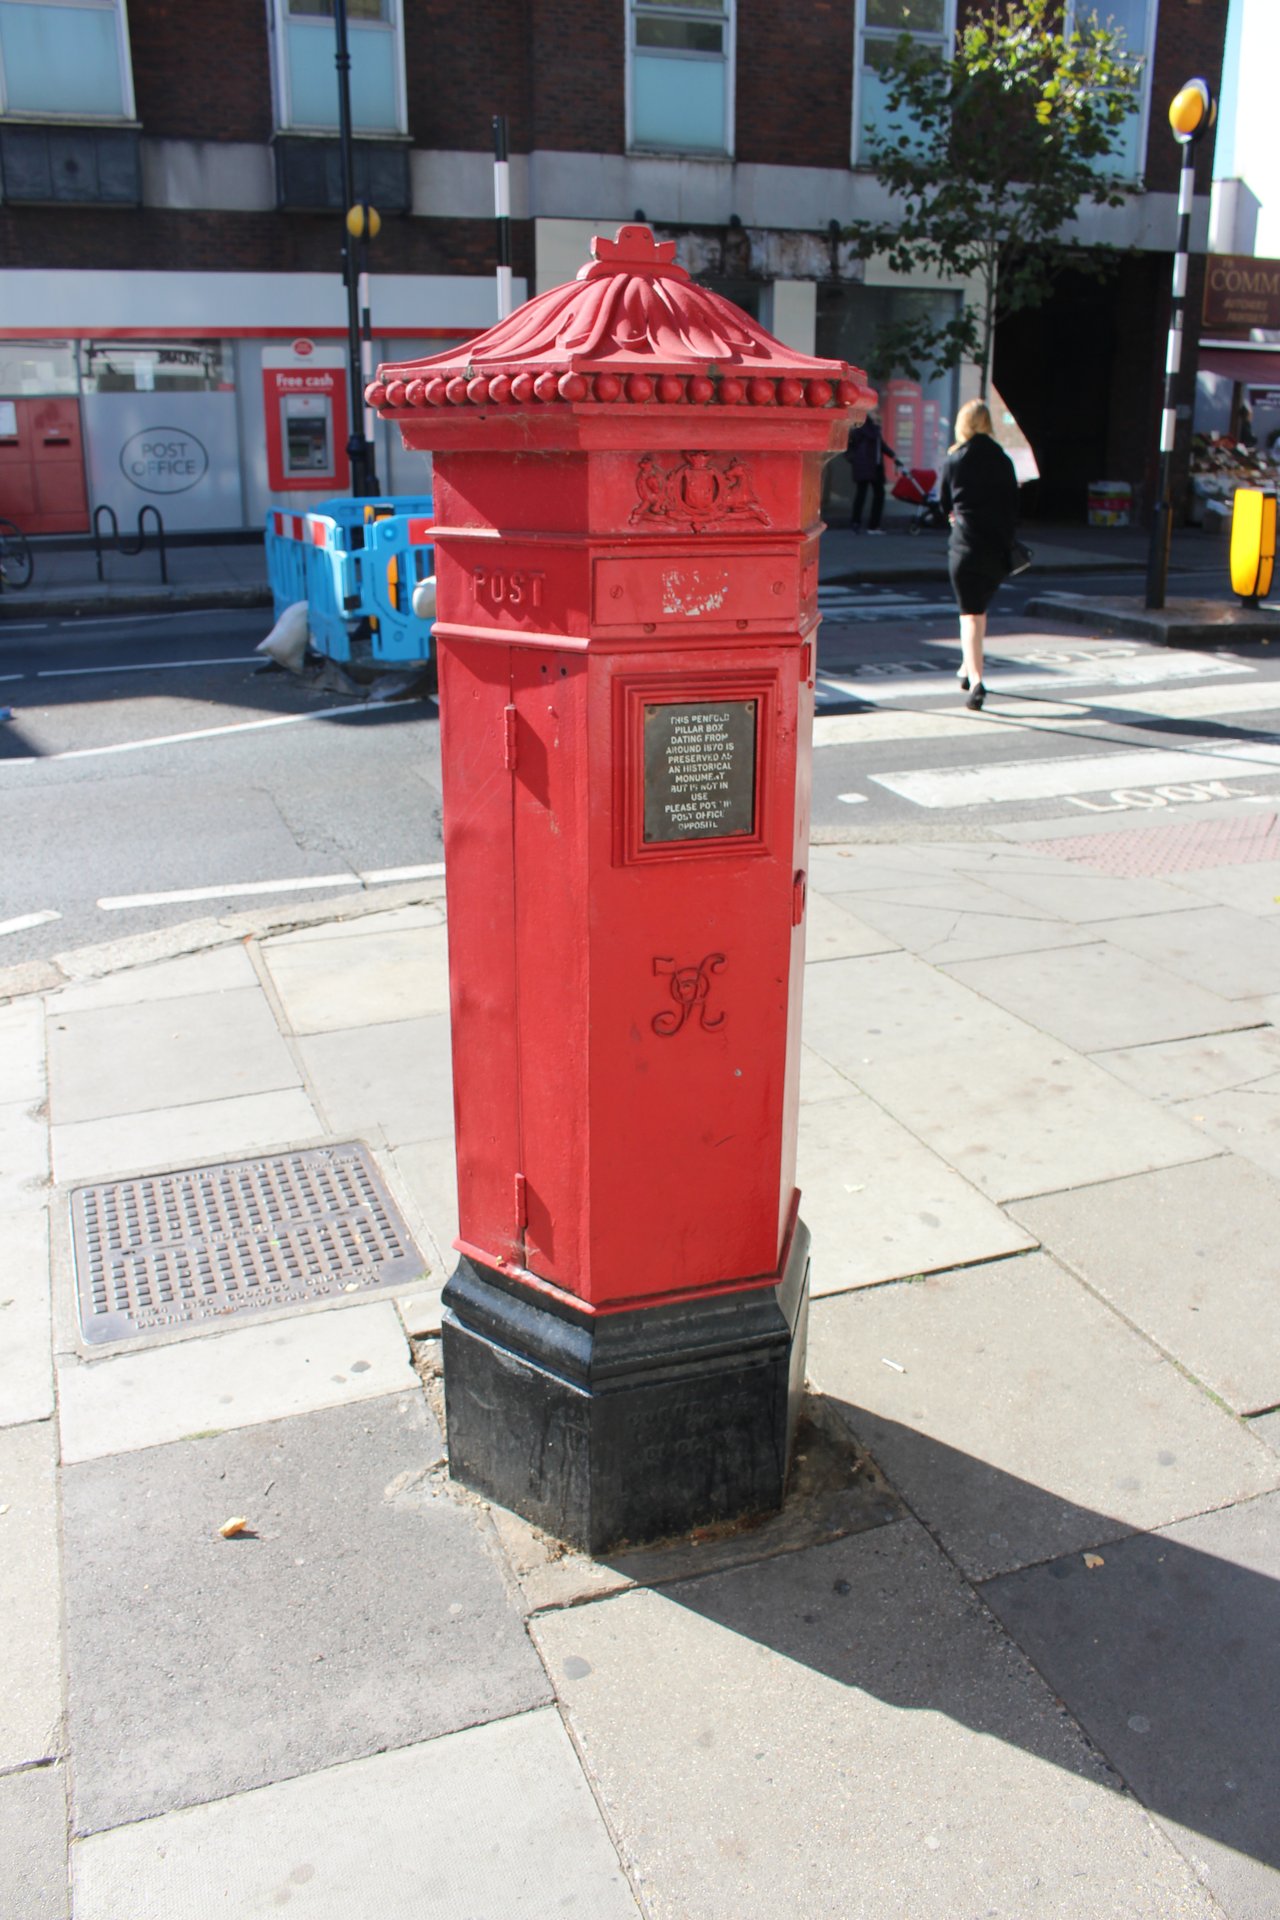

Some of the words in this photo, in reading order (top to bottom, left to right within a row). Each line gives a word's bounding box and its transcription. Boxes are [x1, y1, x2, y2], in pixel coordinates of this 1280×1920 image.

[275, 373, 303, 387] Free
[305, 372, 334, 387] cash
[142, 442, 188, 458] POST
[131, 460, 197, 476] OFFICE
[472, 567, 546, 607] POST
[670, 715, 690, 725] THIS
[675, 725, 704, 735] PILLAR
[706, 723, 724, 733] BOX
[671, 735, 703, 745] DATING
[705, 733, 729, 743] FROM
[666, 745, 702, 755] AROUND
[703, 743, 724, 753] 1870
[725, 742, 735, 751] IS
[668, 753, 719, 764] PRESERVED
[668, 765, 681, 774] AN
[683, 762, 732, 773] HISTORICAL
[675, 772, 726, 784] MONUMENT
[671, 783, 689, 793] BUT
[700, 782, 718, 791] NOT
[719, 781, 729, 790] IN
[691, 792, 708, 802] USE
[1064, 781, 1255, 812] LOOK
[665, 802, 698, 813] PLEASE
[699, 801, 723, 810] POS
[695, 810, 725, 820] OFFICE
